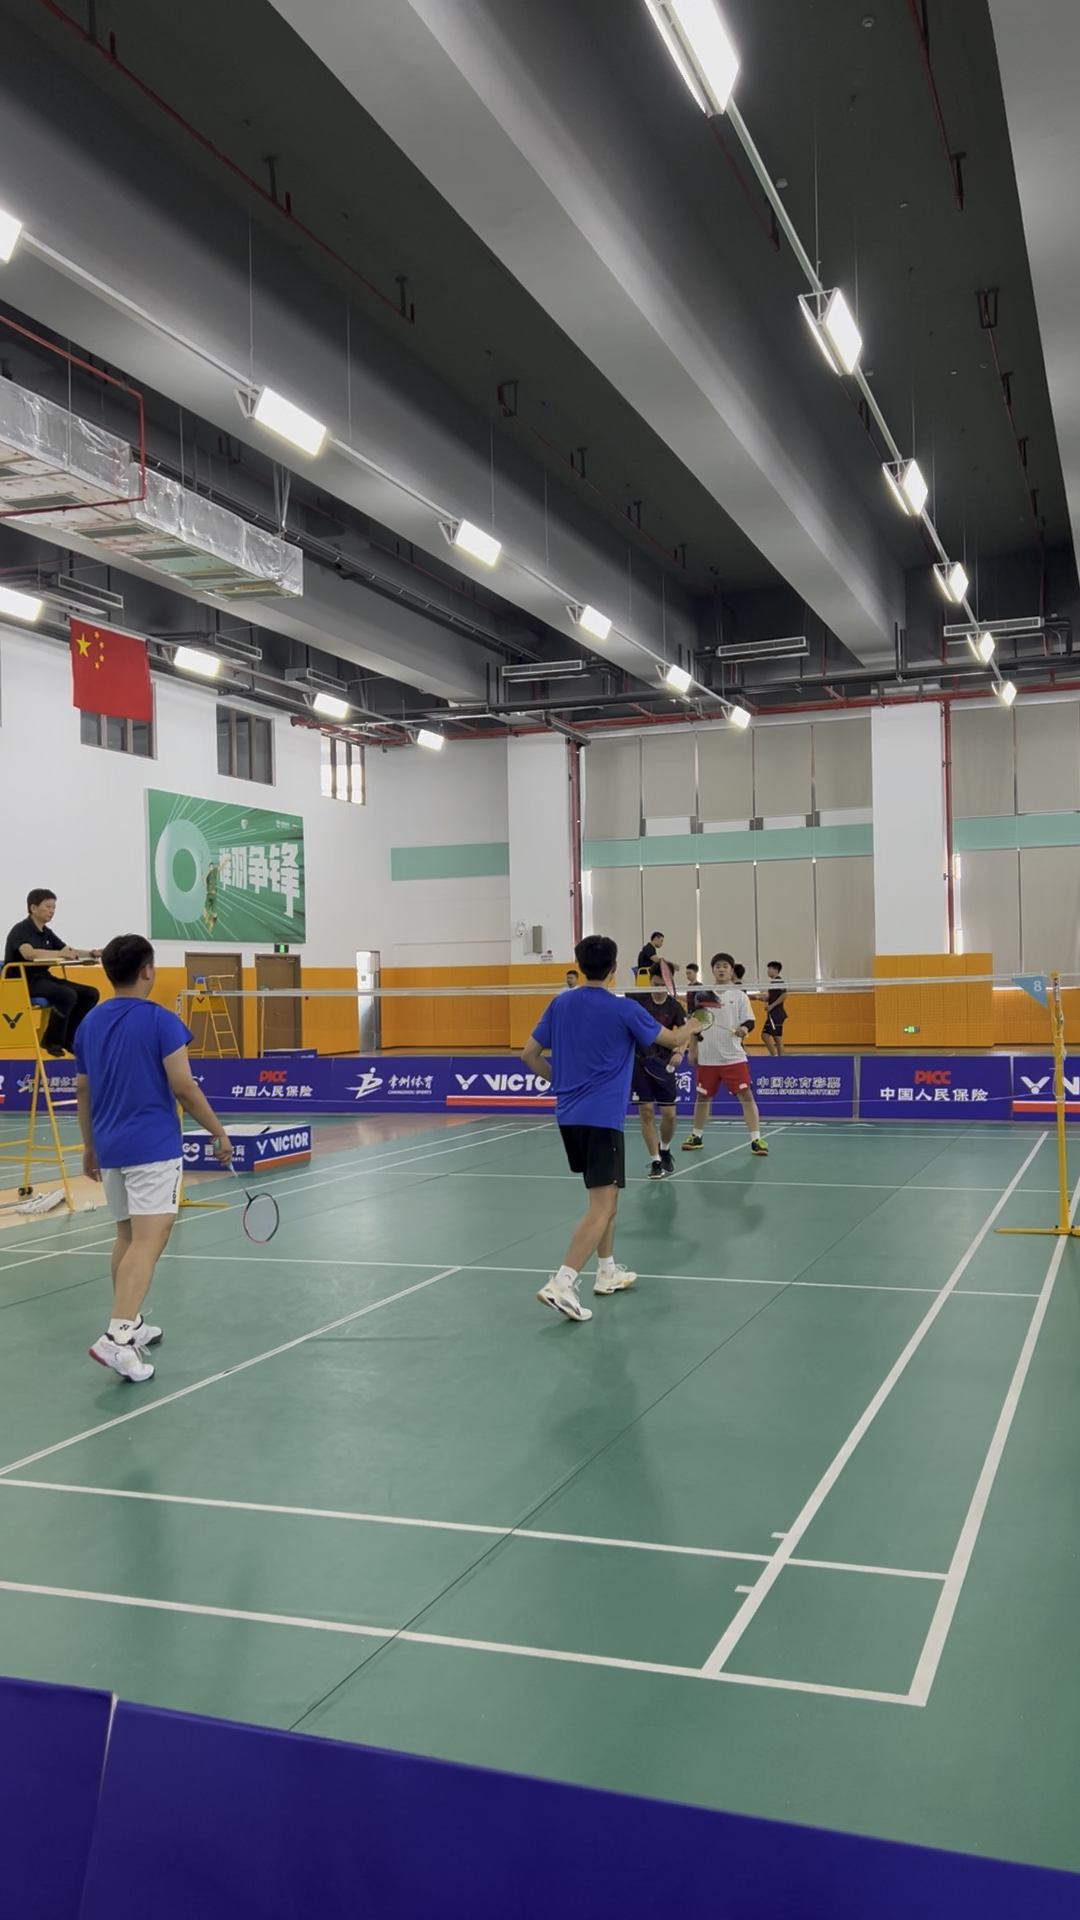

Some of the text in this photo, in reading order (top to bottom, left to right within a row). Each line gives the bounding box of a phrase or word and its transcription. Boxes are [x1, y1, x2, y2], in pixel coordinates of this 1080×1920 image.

[1033, 980, 1043, 993] 8
[259, 1071, 287, 1082] PICC
[388, 1073, 434, 1090] 常州体育
[482, 1073, 552, 1092] VICTO
[756, 1076, 841, 1089] 中国体育彩票
[914, 1070, 951, 1084] PICC
[231, 1085, 313, 1098] 中国人民保险
[880, 1087, 989, 1102] 中国人民保险
[270, 1131, 309, 1152] VICTOR
